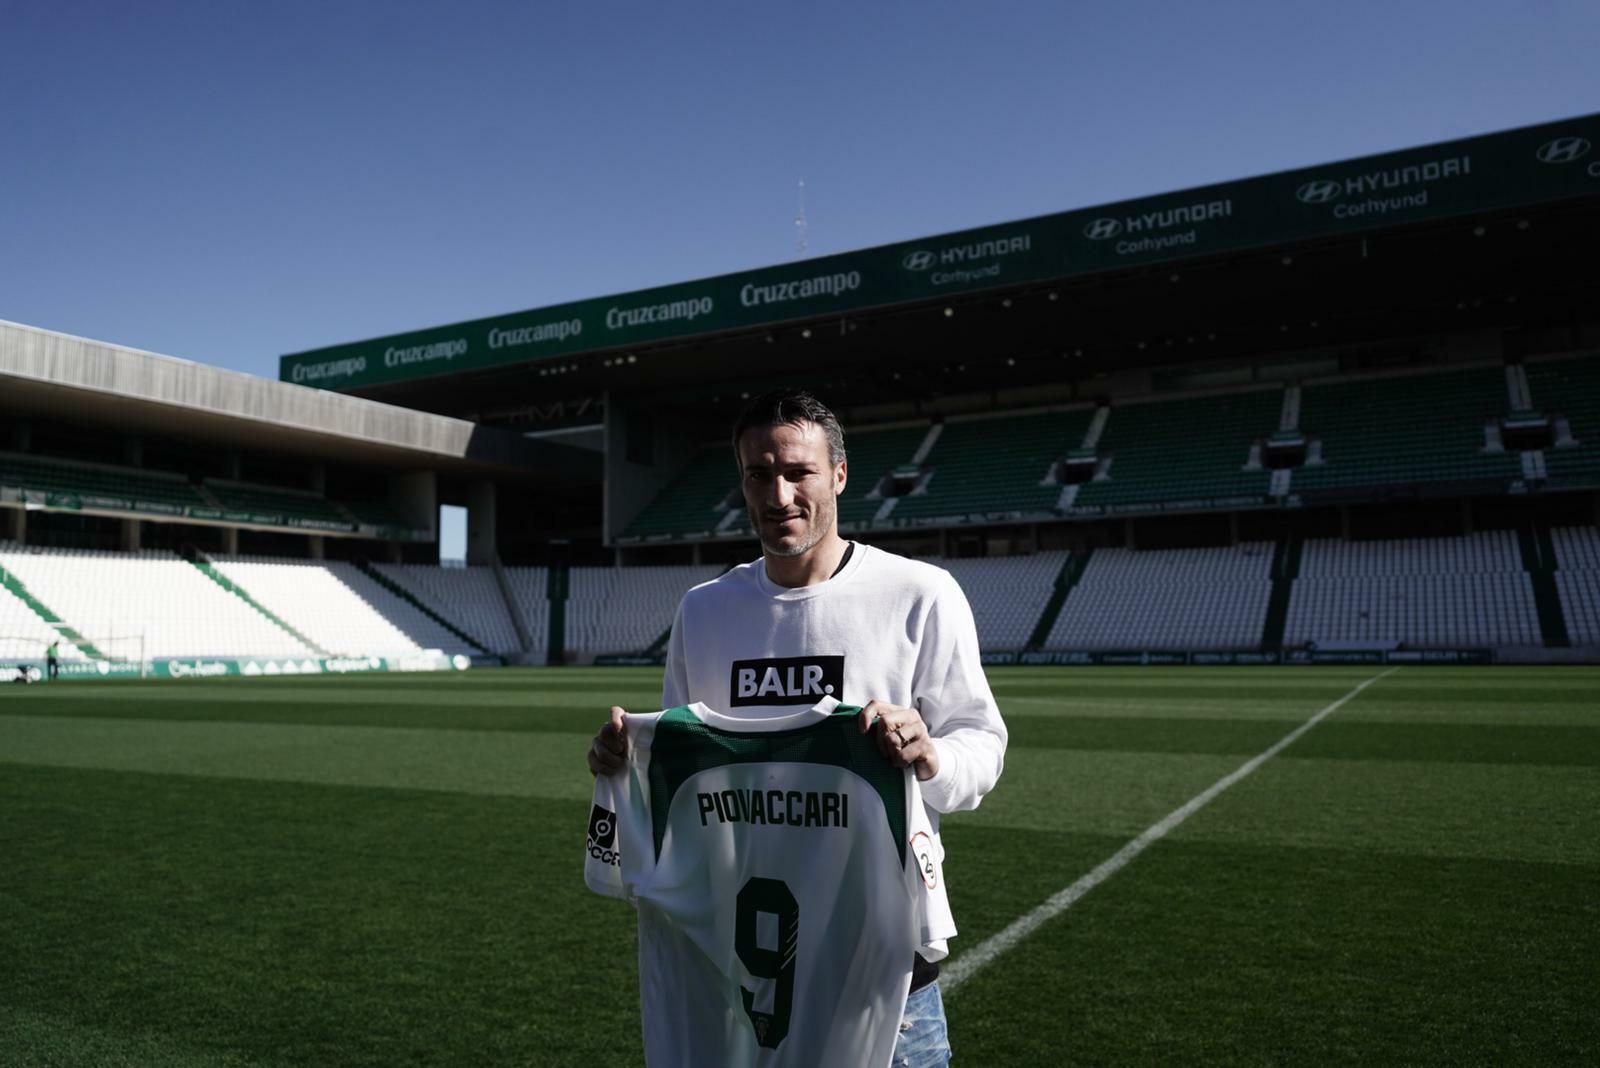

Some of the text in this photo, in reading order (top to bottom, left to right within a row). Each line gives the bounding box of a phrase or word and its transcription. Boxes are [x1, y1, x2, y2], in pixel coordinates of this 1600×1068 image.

[1346, 155, 1470, 195] HYUNDAI
[1126, 199, 1232, 234] HYUNDAI
[1333, 190, 1428, 220] Corhyund
[940, 234, 1031, 266] HYUNDAI
[1115, 229, 1196, 256] Corhyund
[741, 268, 861, 308] Cruzcampo
[606, 294, 714, 331] Cruzcampo
[488, 317, 583, 350] Cruzcampo
[291, 355, 367, 383] Cruzcampo
[384, 336, 468, 369] Cruzcampo
[737, 665, 835, 698] BALR.
[696, 789, 849, 828] PIOVACCARI
[734, 876, 800, 1050] 9
